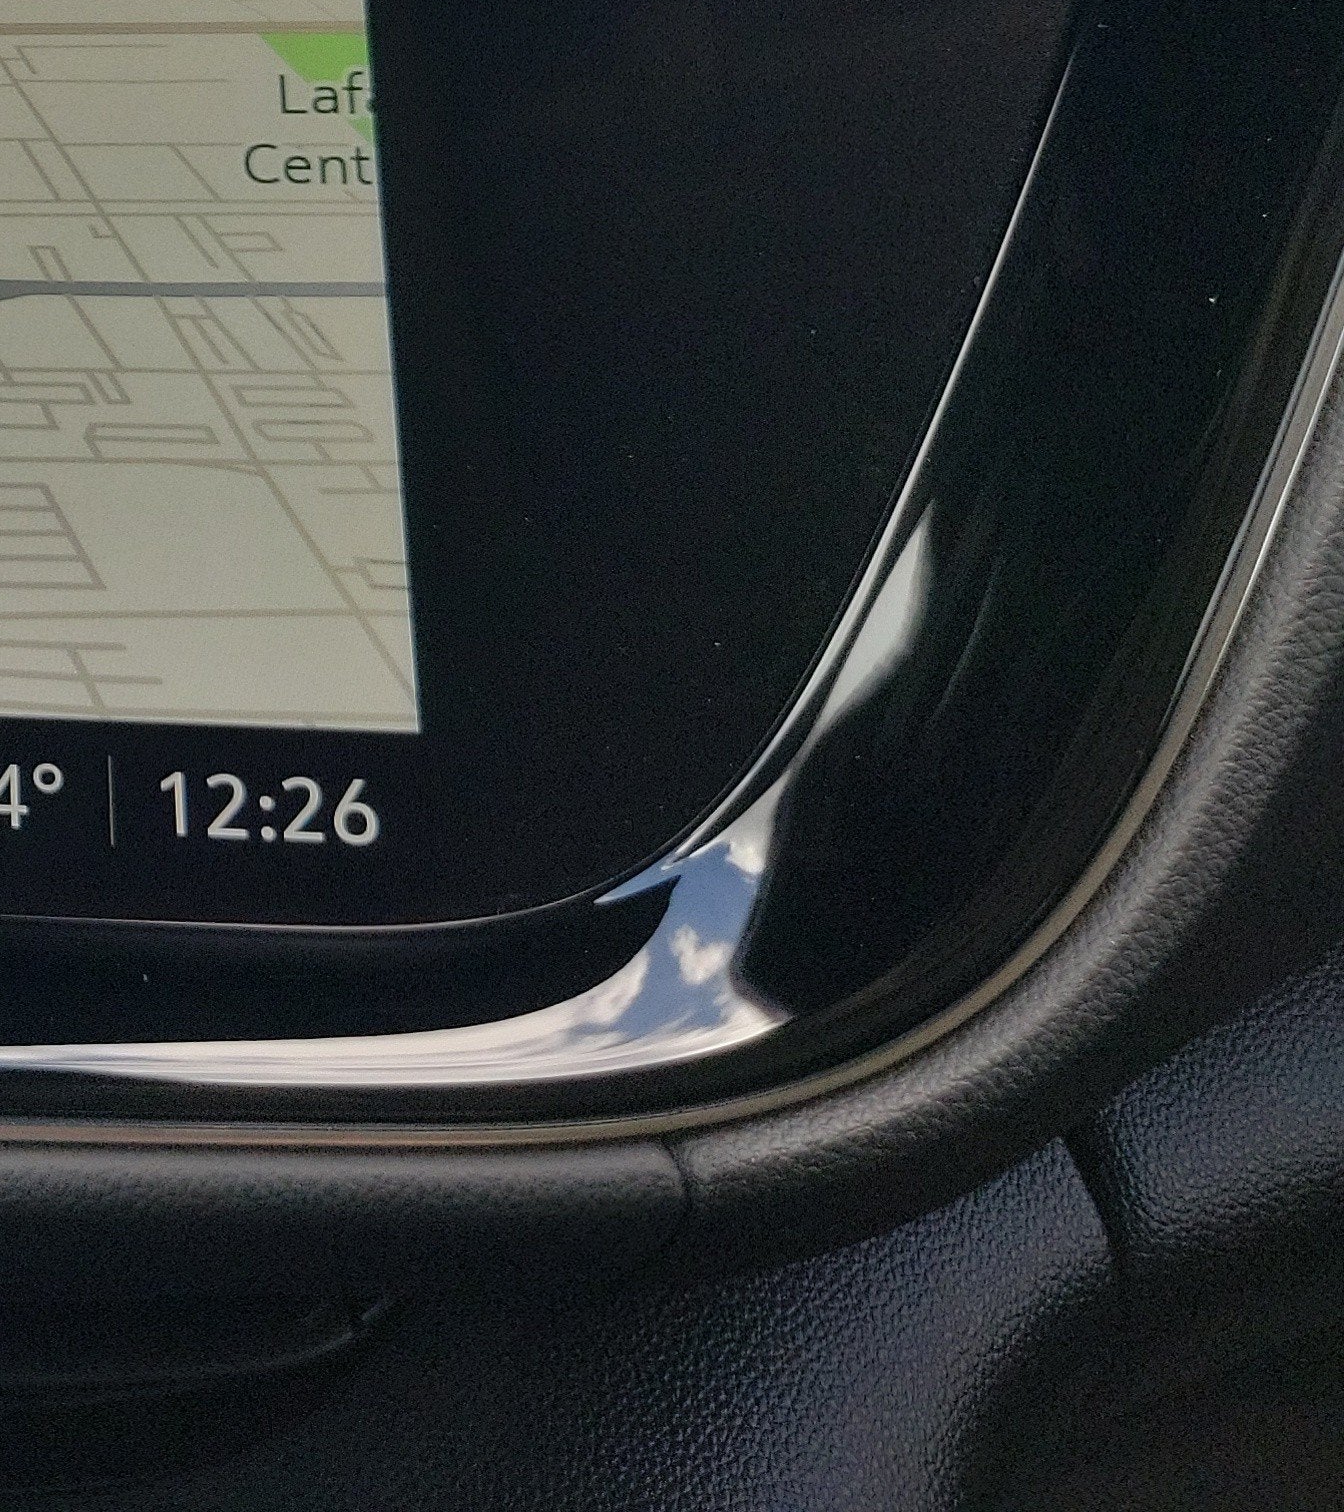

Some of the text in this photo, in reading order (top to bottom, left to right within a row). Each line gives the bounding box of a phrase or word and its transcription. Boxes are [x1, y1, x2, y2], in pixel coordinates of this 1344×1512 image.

[277, 69, 373, 116] Laf
[244, 143, 374, 186] Cent
[160, 769, 381, 846] 12:26
